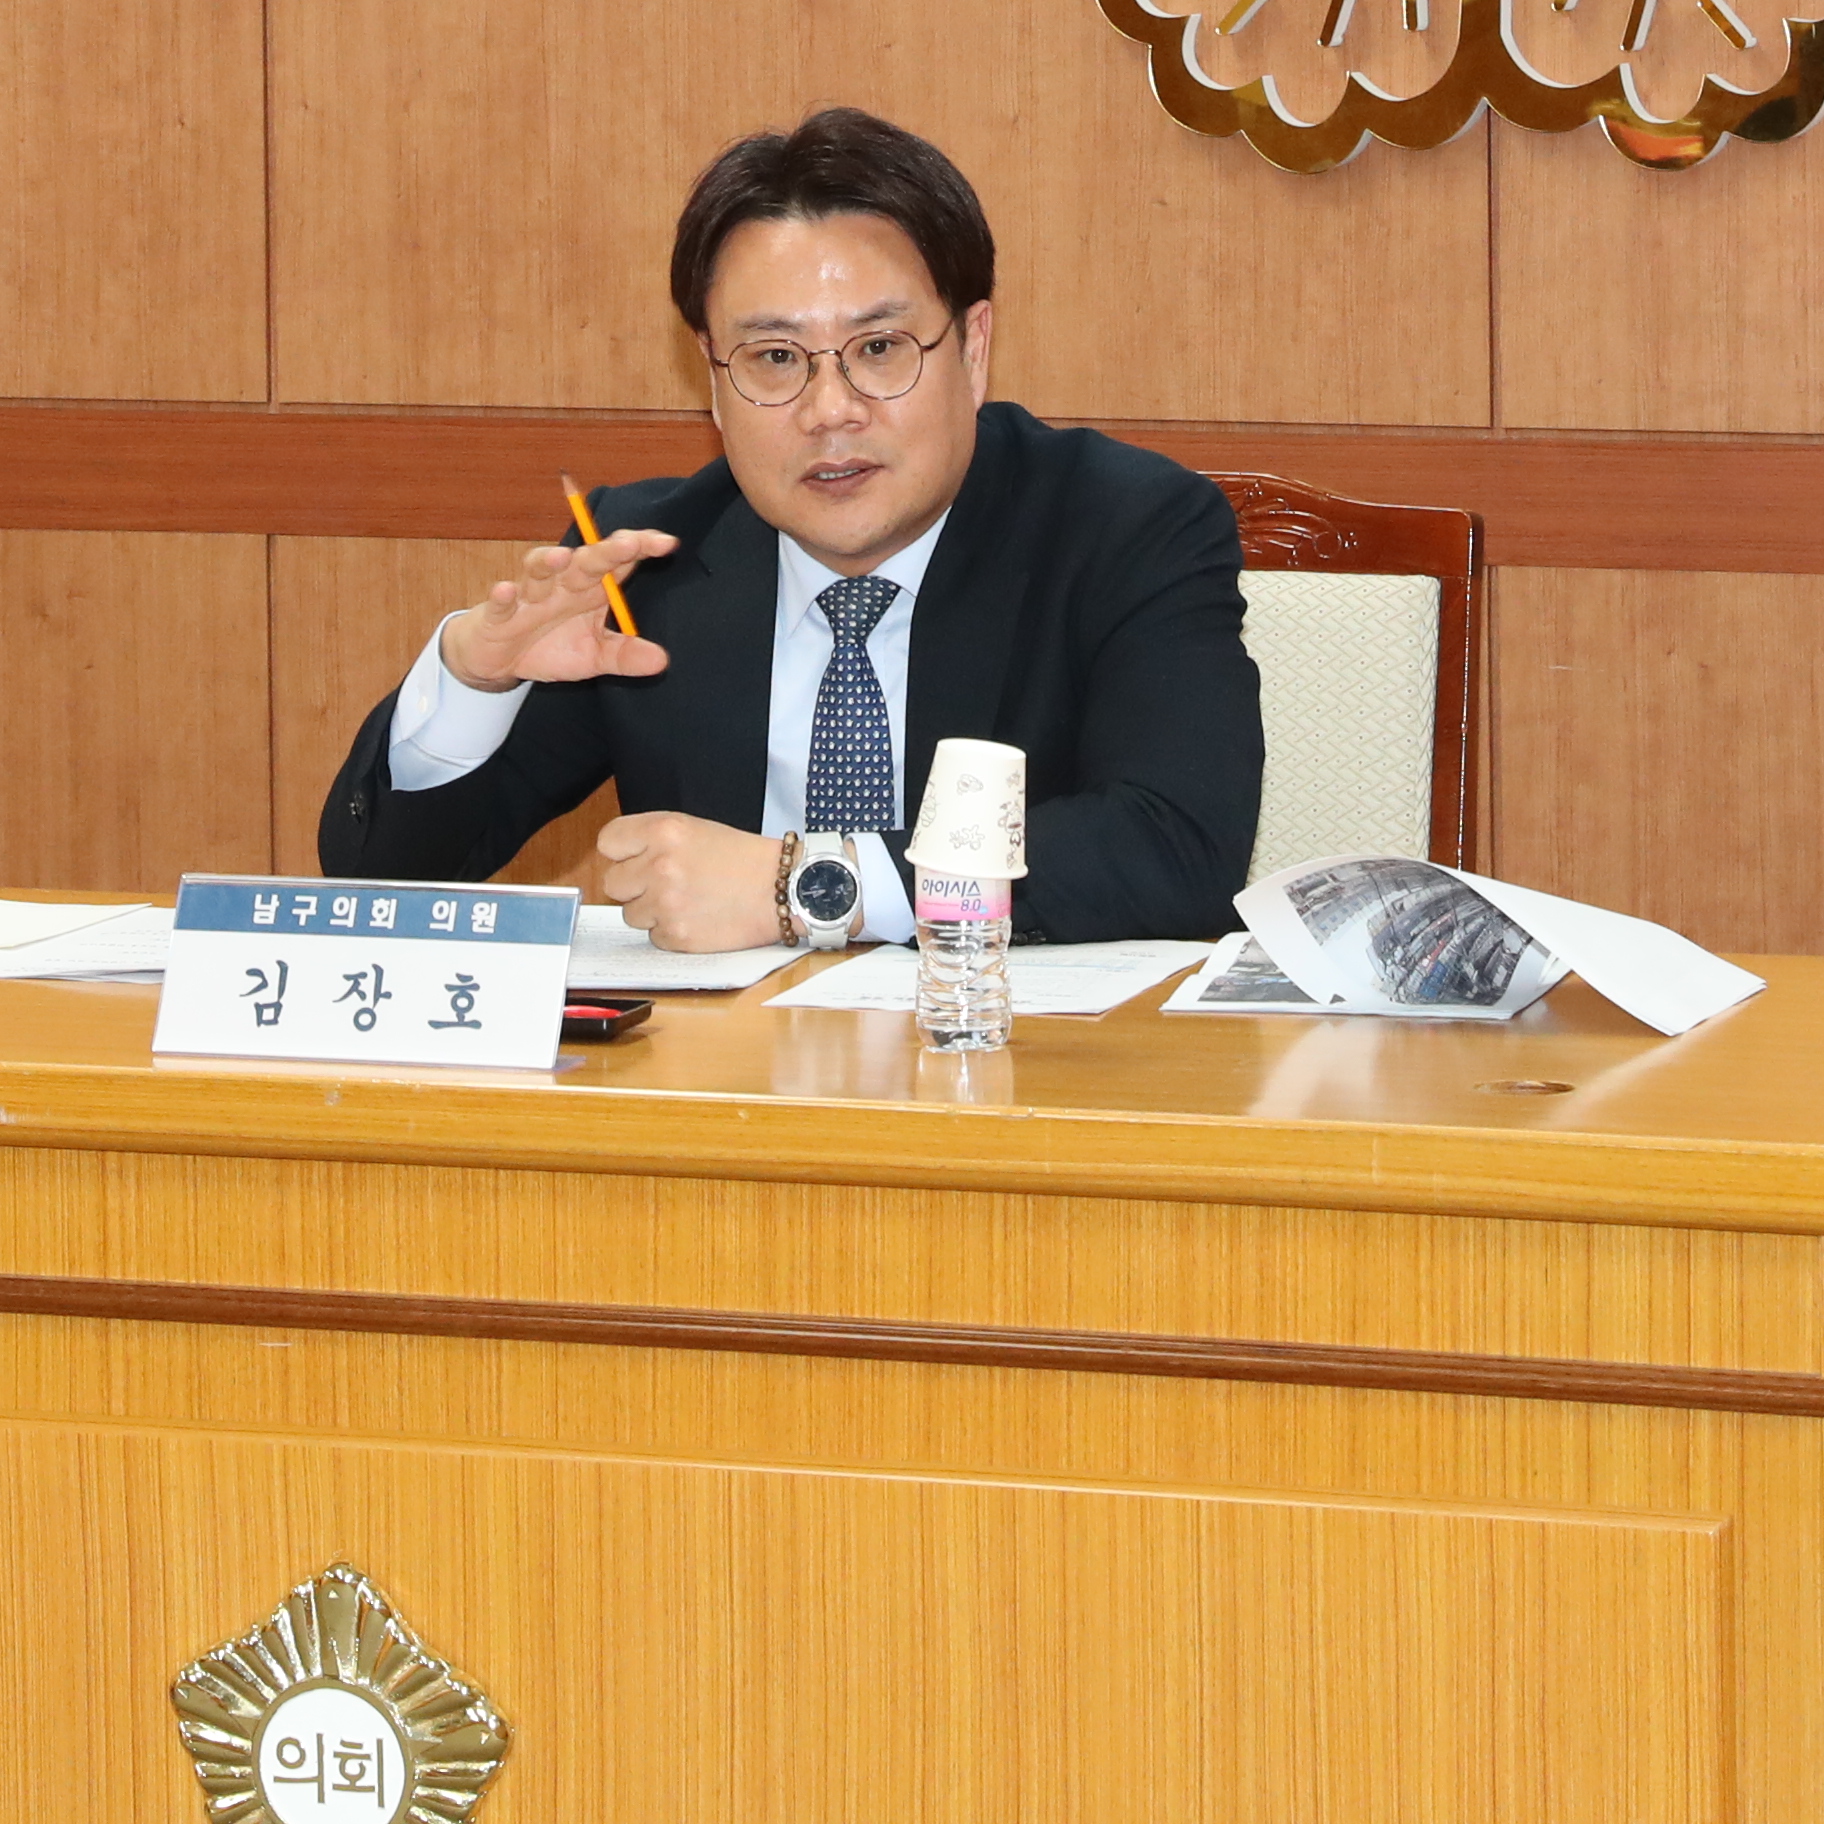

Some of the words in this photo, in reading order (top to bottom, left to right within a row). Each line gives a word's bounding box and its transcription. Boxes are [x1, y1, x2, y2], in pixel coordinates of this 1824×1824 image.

[253, 893, 398, 930] 남구의회
[429, 899, 499, 934] 의원
[922, 879, 981, 898] 아이시스
[239, 959, 483, 1032] 김장호
[272, 1732, 386, 1809] 의회
